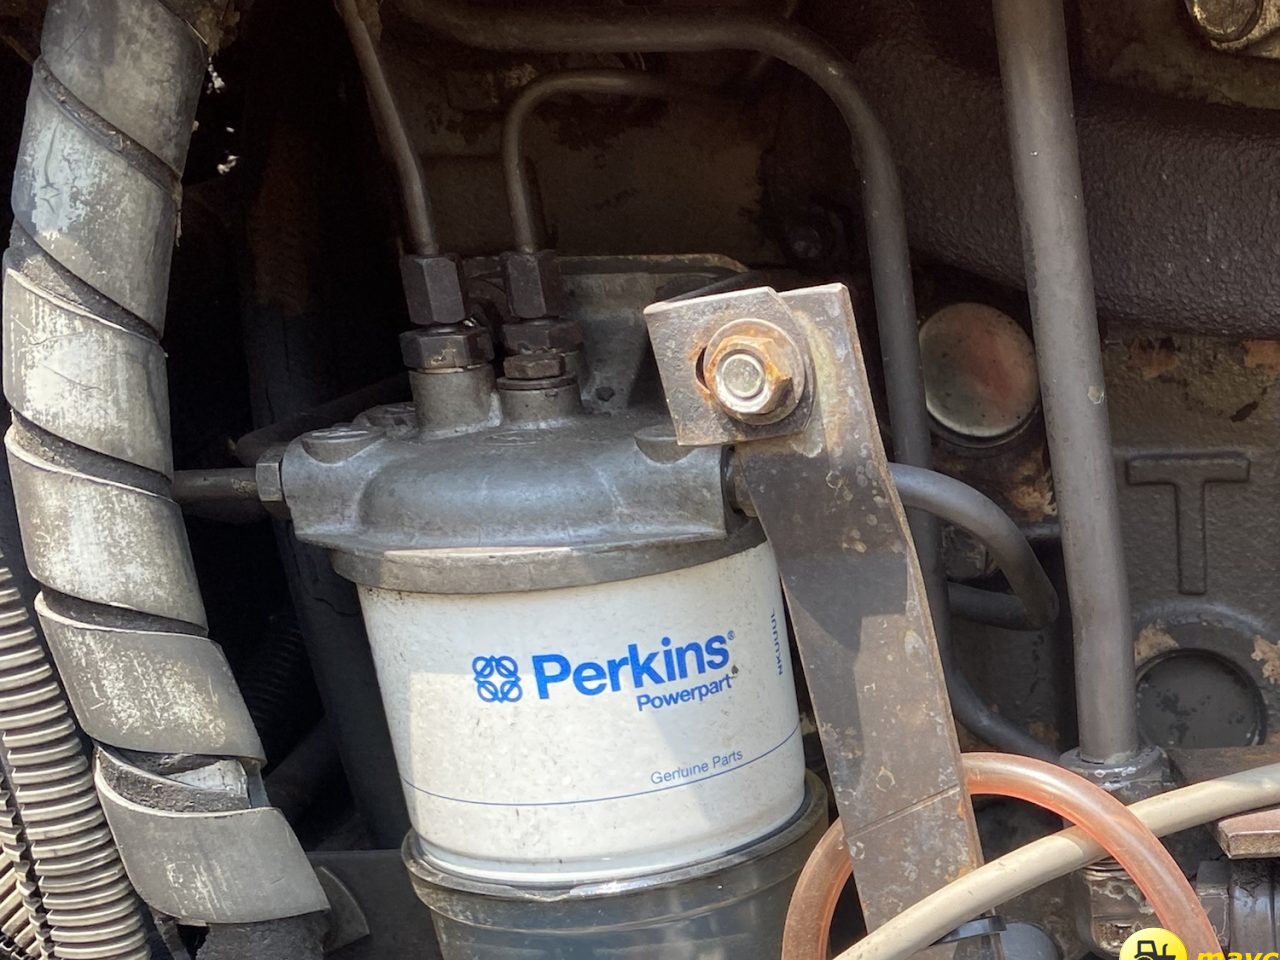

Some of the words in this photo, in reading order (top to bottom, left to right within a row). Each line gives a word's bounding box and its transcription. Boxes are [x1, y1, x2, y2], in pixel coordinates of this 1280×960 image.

[531, 634, 731, 700] Perkins
[636, 673, 733, 712] Powerpart
[650, 762, 709, 785] Genuine
[712, 749, 744, 769] Parts
